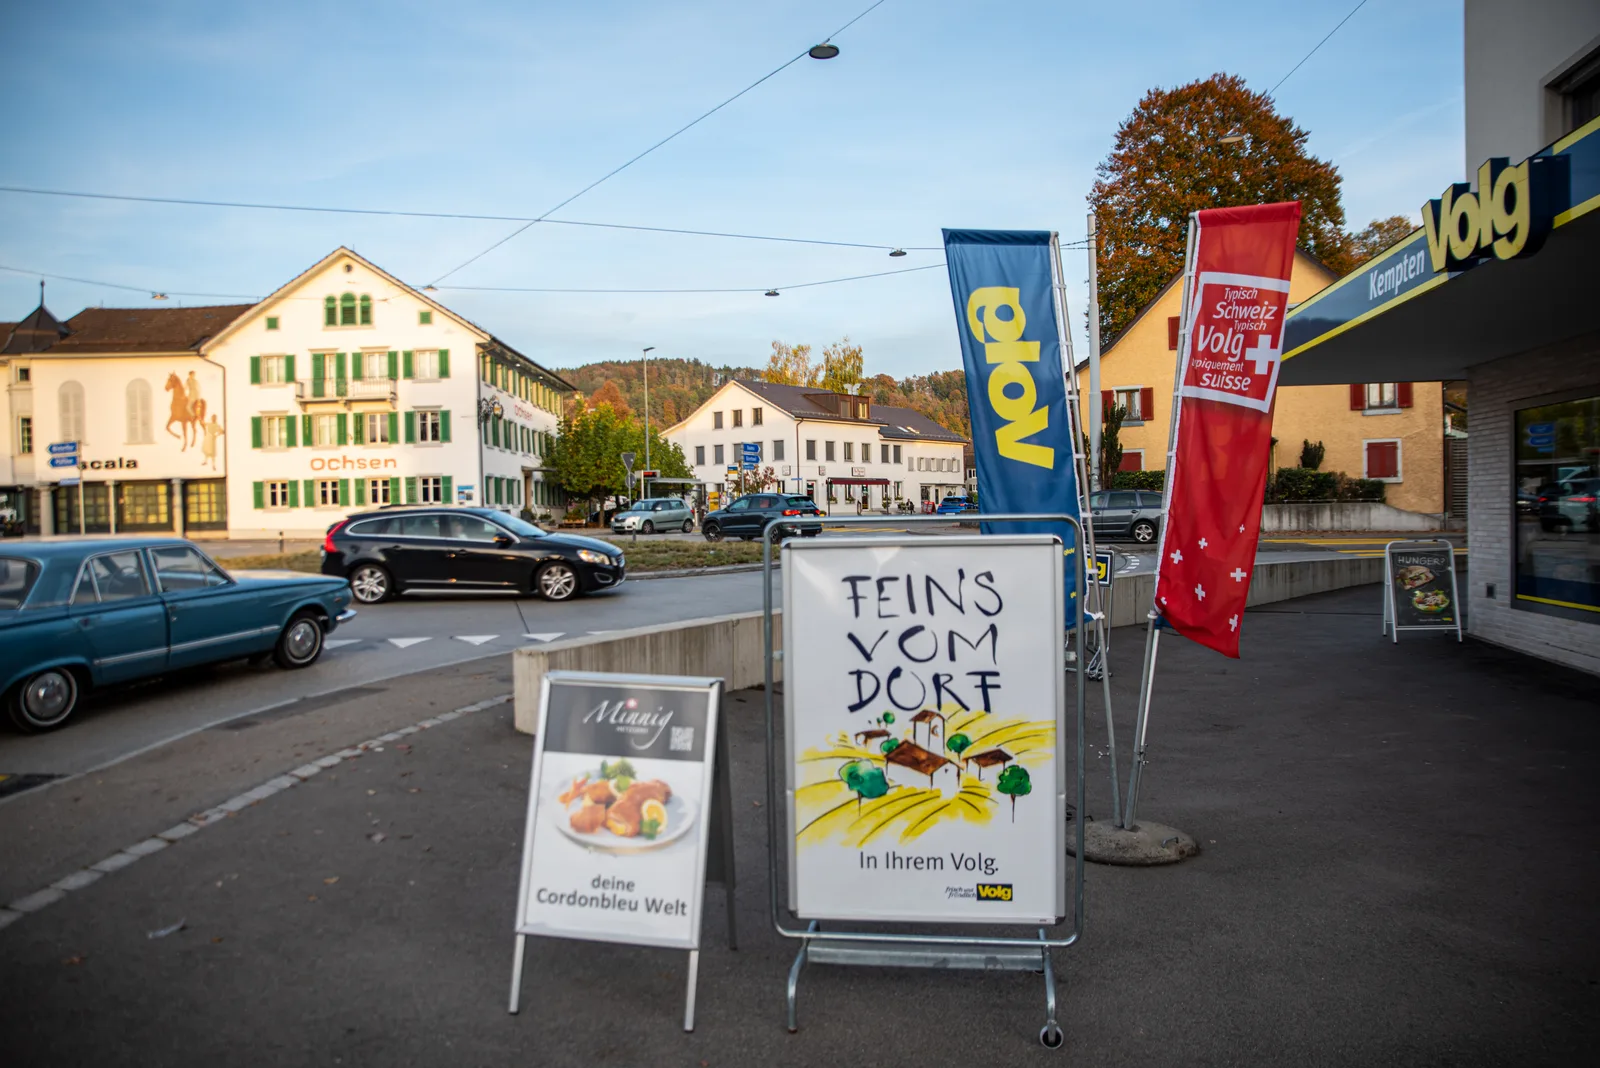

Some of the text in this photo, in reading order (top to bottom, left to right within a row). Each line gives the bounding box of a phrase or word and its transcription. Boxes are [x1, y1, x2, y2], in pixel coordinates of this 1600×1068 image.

[1421, 158, 1530, 273] Volg
[1369, 249, 1425, 301] Kempten
[1224, 287, 1258, 303] Typisch
[1212, 301, 1278, 320] Schweiz
[1233, 320, 1267, 333] Typisch
[1197, 324, 1245, 362] Volg
[1200, 371, 1251, 391] suisse
[79, 457, 137, 469] scala
[1398, 556, 1446, 565] HUNGER?
[847, 623, 998, 665] VOM
[847, 666, 1001, 713] DORF
[582, 699, 674, 751] Minnig
[860, 851, 999, 876] In Ihrem Volg.
[592, 875, 635, 892] deine
[978, 885, 1012, 901] Volg
[536, 888, 688, 916] Cordonbleu Welt
